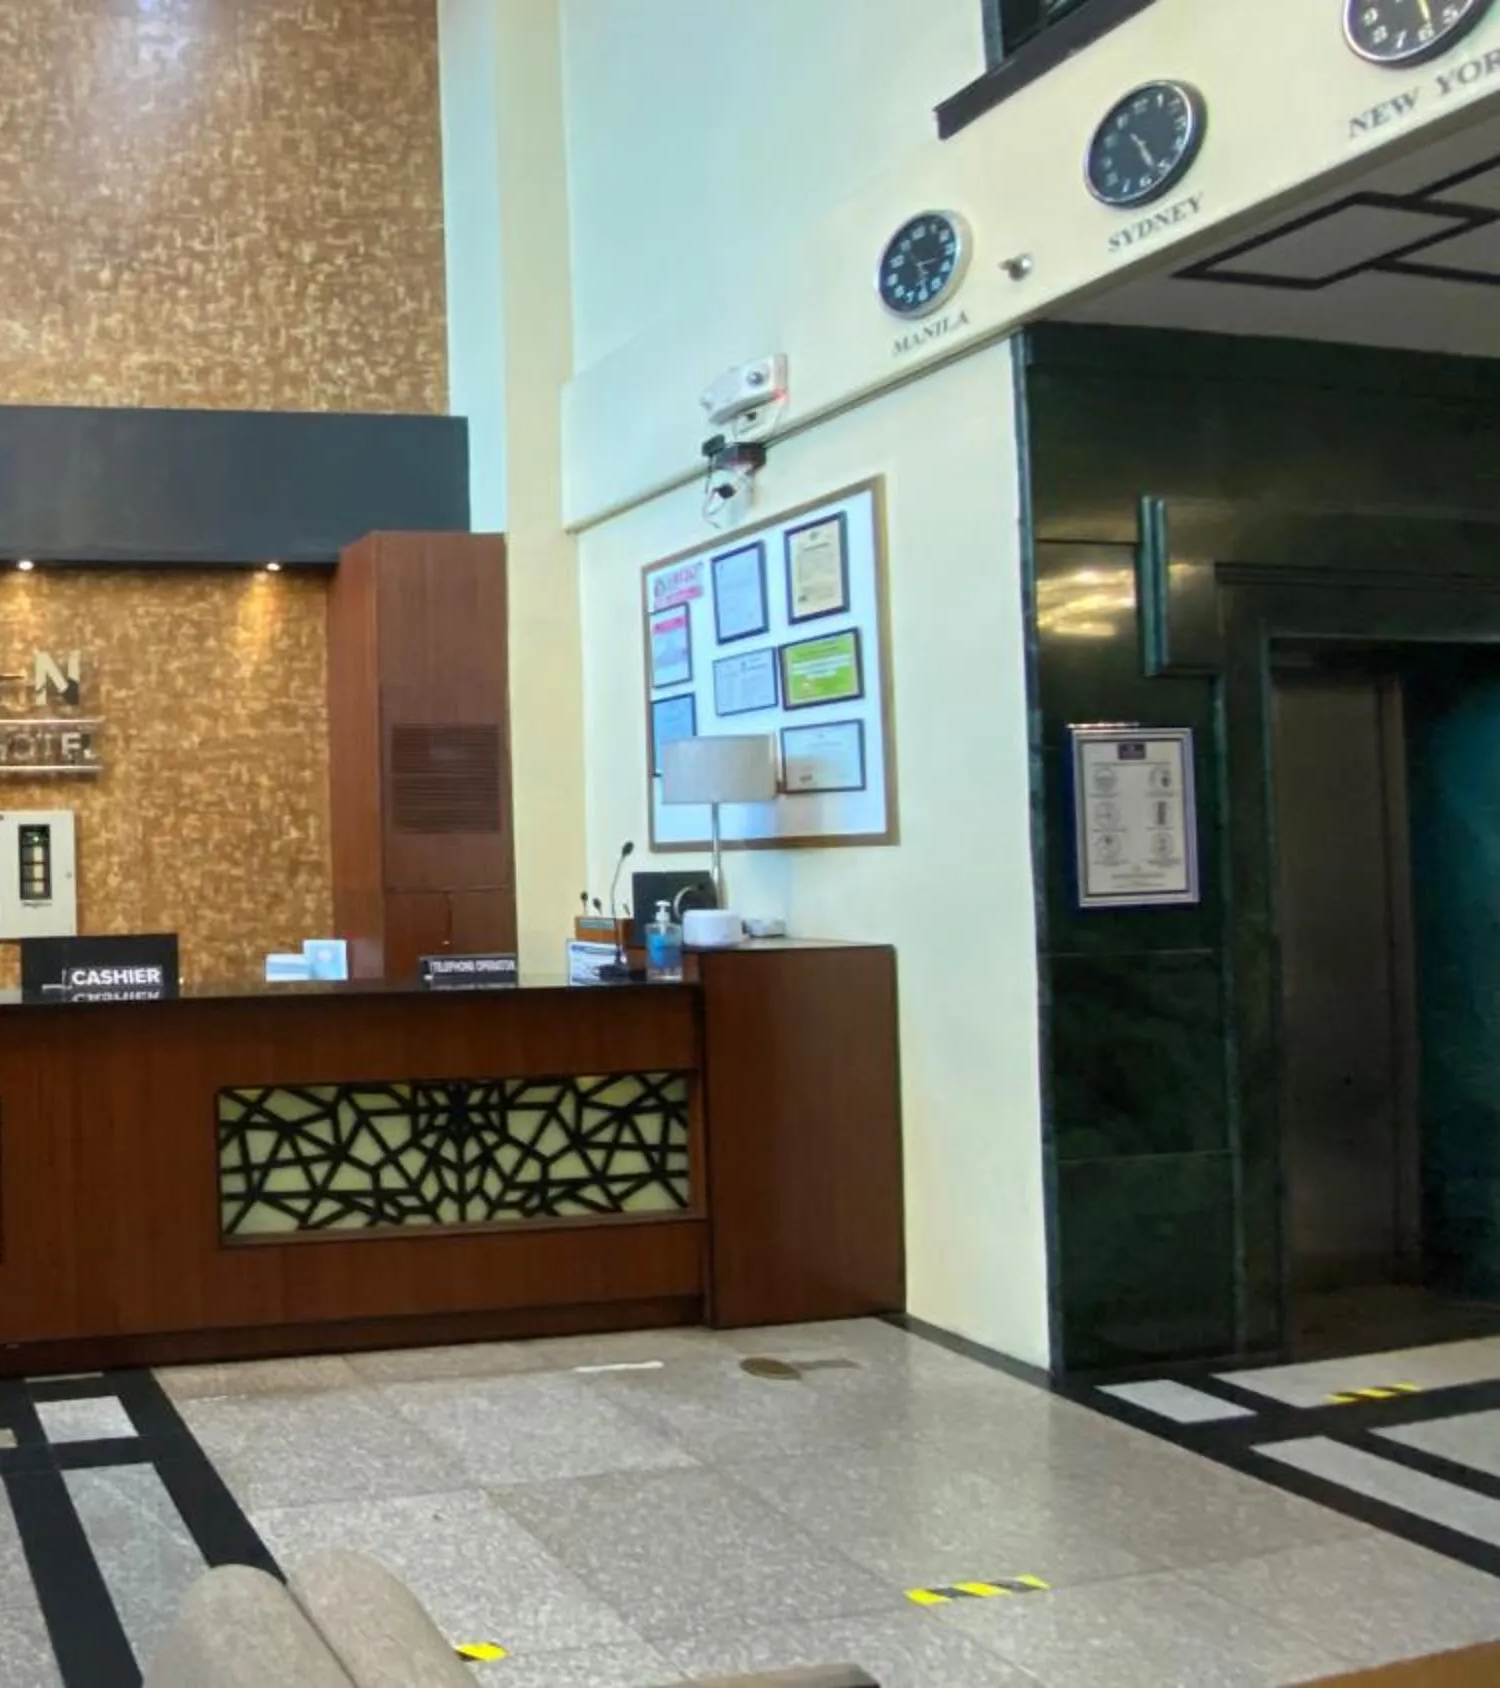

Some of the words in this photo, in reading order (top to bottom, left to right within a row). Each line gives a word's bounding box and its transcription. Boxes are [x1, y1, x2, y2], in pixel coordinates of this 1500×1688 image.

[1363, 7, 1378, 26] 9
[1349, 86, 1419, 138] NEW
[1435, 48, 1500, 96] YOR
[1108, 192, 1202, 252] SYDNEY
[892, 310, 968, 356] MANILA
[71, 967, 161, 985] CASHIER
